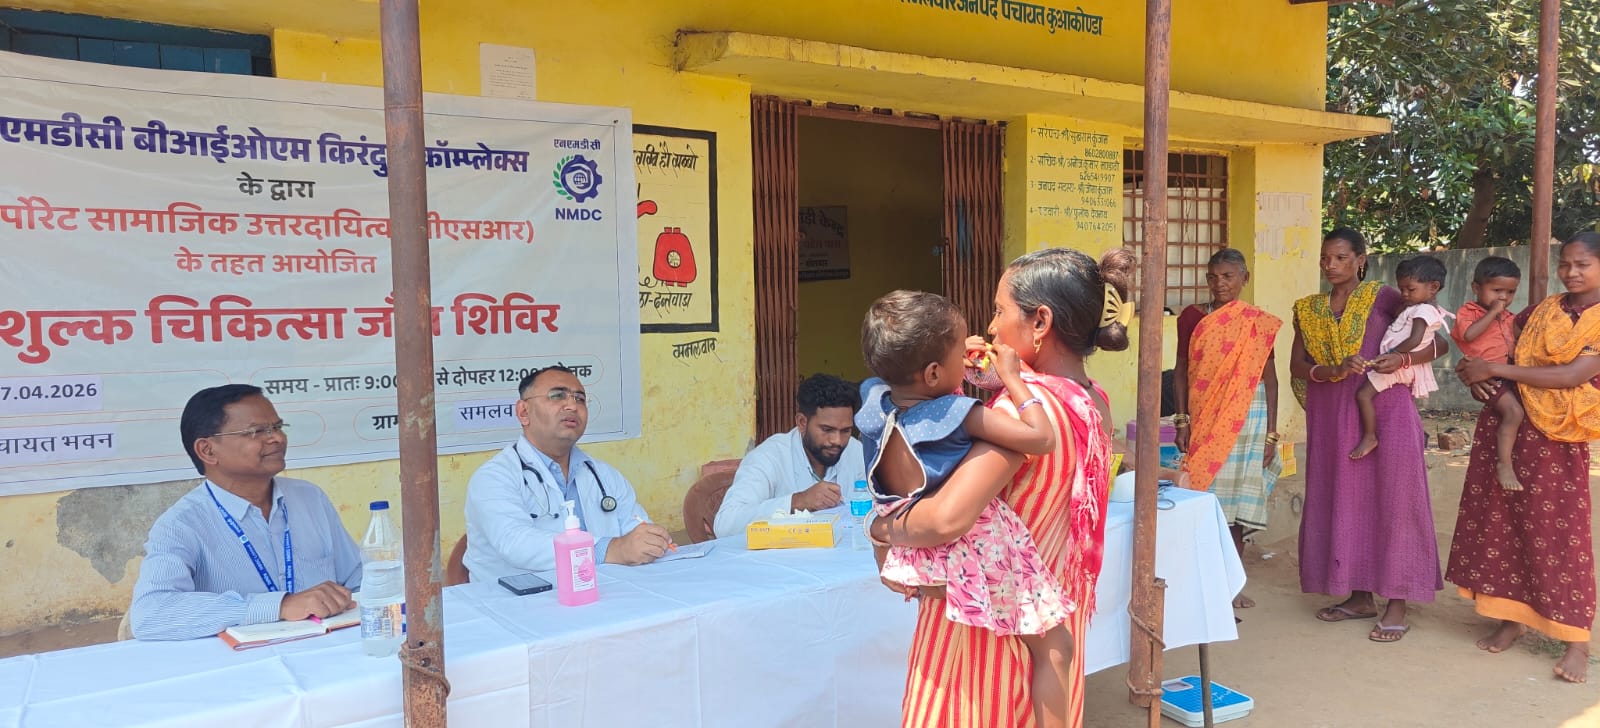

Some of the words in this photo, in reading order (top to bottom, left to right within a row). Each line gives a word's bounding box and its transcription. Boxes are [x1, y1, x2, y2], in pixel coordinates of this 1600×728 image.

[132, 120, 312, 163] बीआईओएम
[318, 133, 388, 177] किरंदु
[236, 172, 264, 198] के
[268, 178, 316, 201] द्वारा
[85, 202, 240, 235] सामाजिक
[245, 208, 391, 240] उत्तरदायित्व
[555, 207, 602, 221] NMDC
[175, 247, 203, 273] के
[208, 254, 265, 275] तहत
[272, 249, 377, 274] आयोजित
[145, 294, 347, 344] चिकित्सा
[450, 292, 561, 336] शिविर
[0, 383, 97, 401] 7.04.2026
[264, 378, 310, 395] समय
[435, 367, 450, 385] से
[452, 366, 496, 387] दोपहर
[458, 403, 517, 420] समलव
[61, 433, 115, 450] भवन
